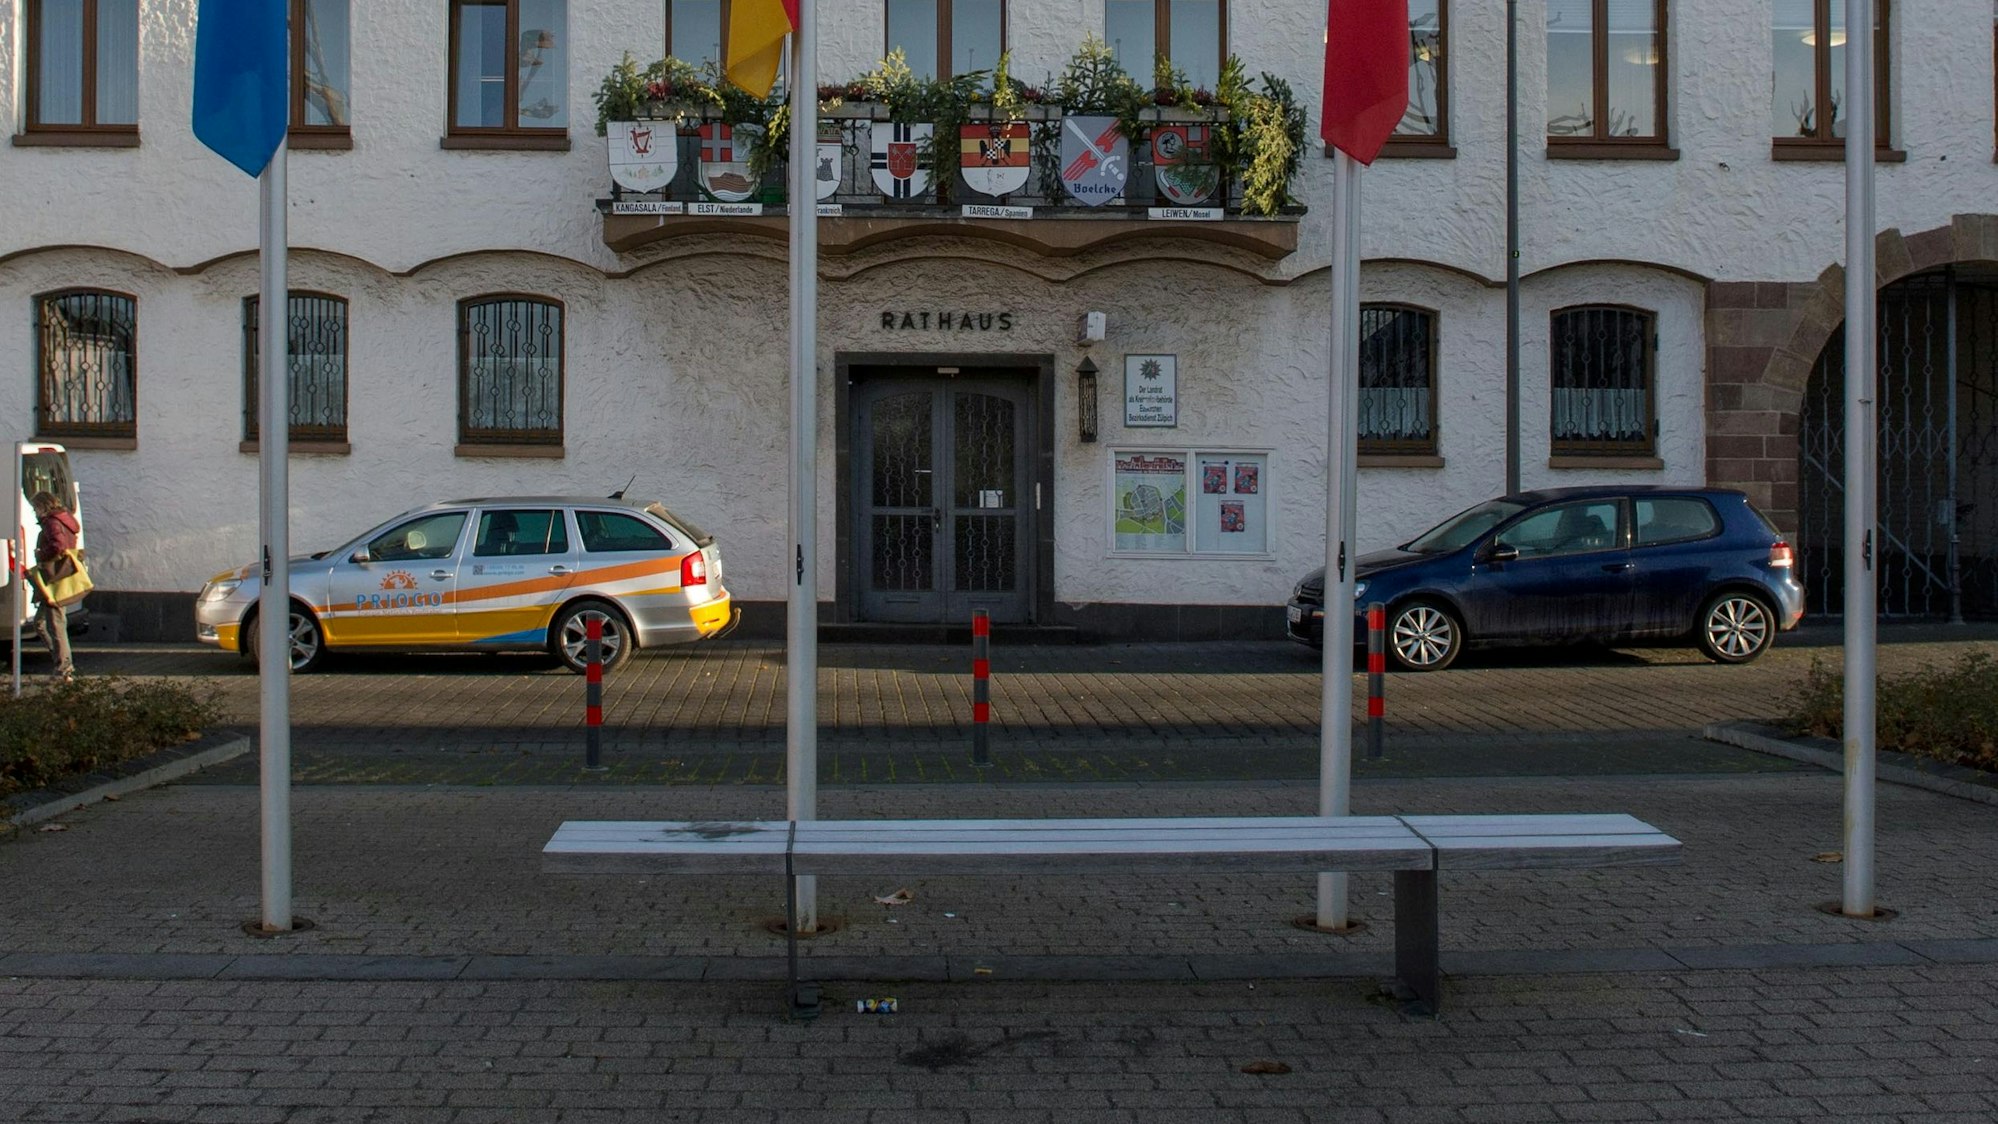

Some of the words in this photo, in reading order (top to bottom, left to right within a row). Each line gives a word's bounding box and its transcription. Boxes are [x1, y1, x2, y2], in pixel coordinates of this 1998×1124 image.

[1073, 183, 1117, 194] Boelcke
[881, 311, 1013, 331] RATHAUS
[356, 591, 441, 608] PRIOGO
